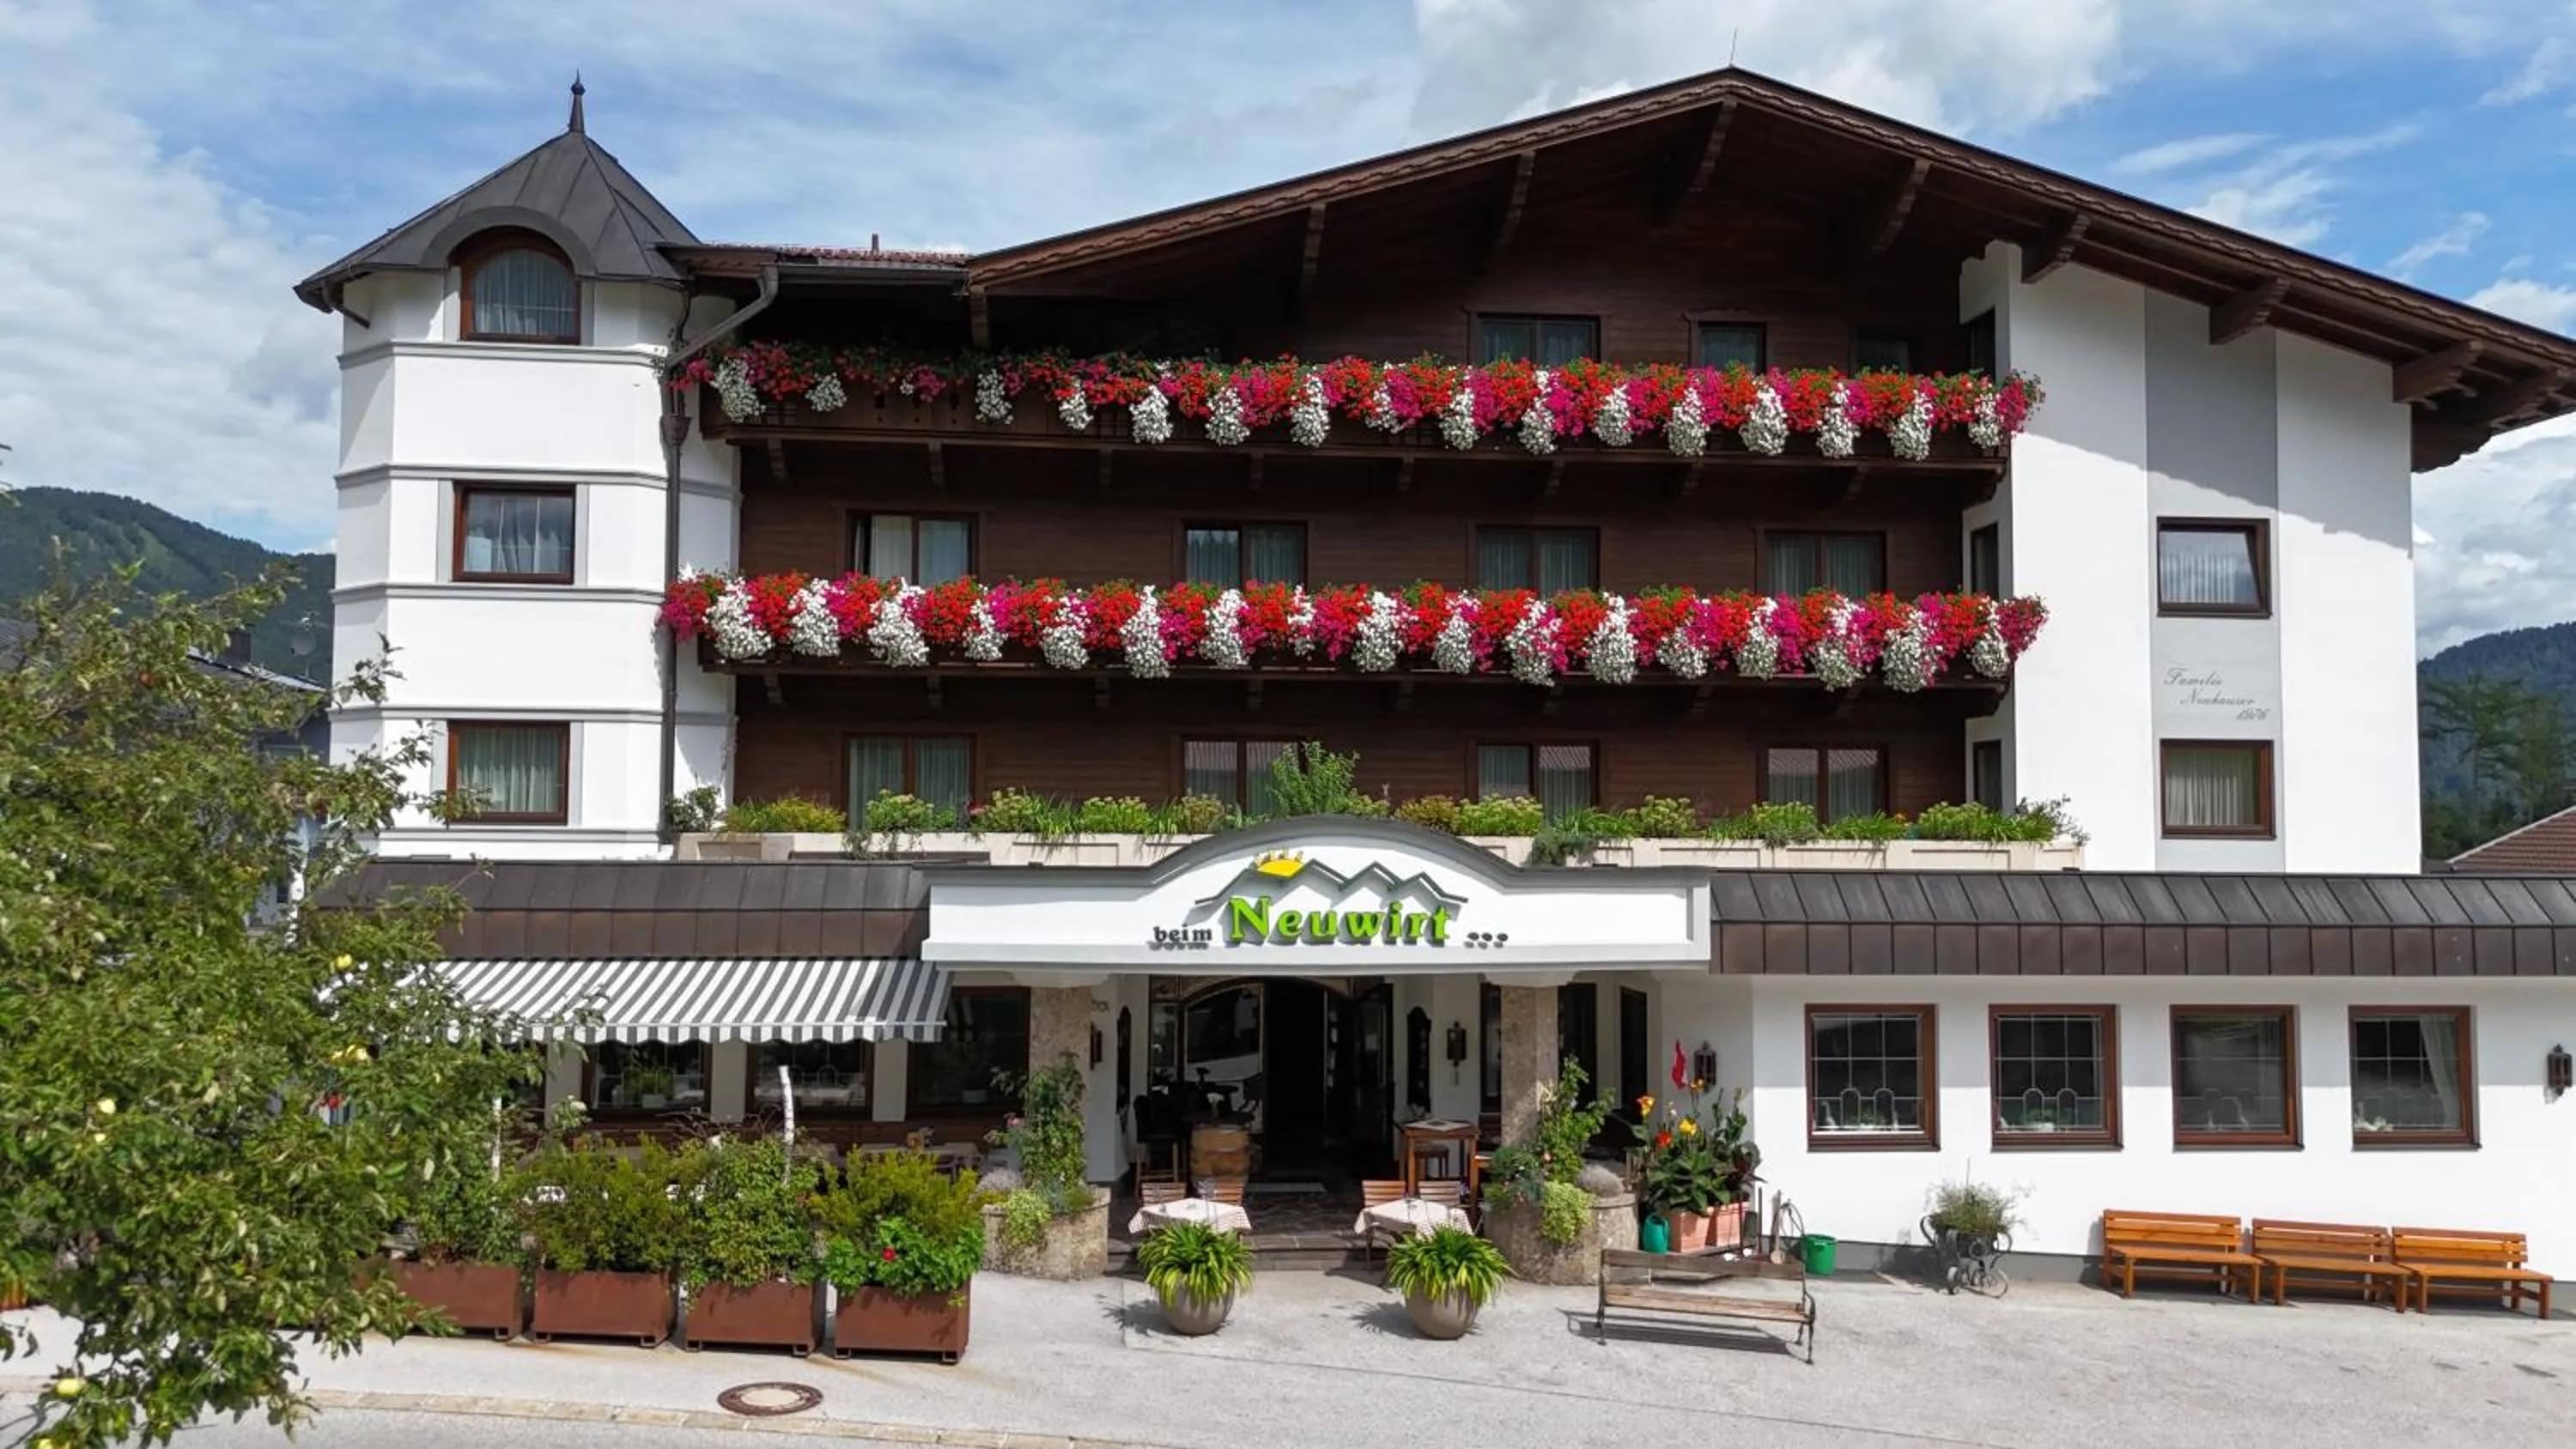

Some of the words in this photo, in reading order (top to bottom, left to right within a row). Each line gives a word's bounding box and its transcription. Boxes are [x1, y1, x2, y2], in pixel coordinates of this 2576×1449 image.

[2163, 667, 2224, 686] Familie
[2178, 688, 2256, 706] Neuhauser
[1152, 923, 1212, 943] beim
[1228, 895, 1452, 942] Neuwirt
